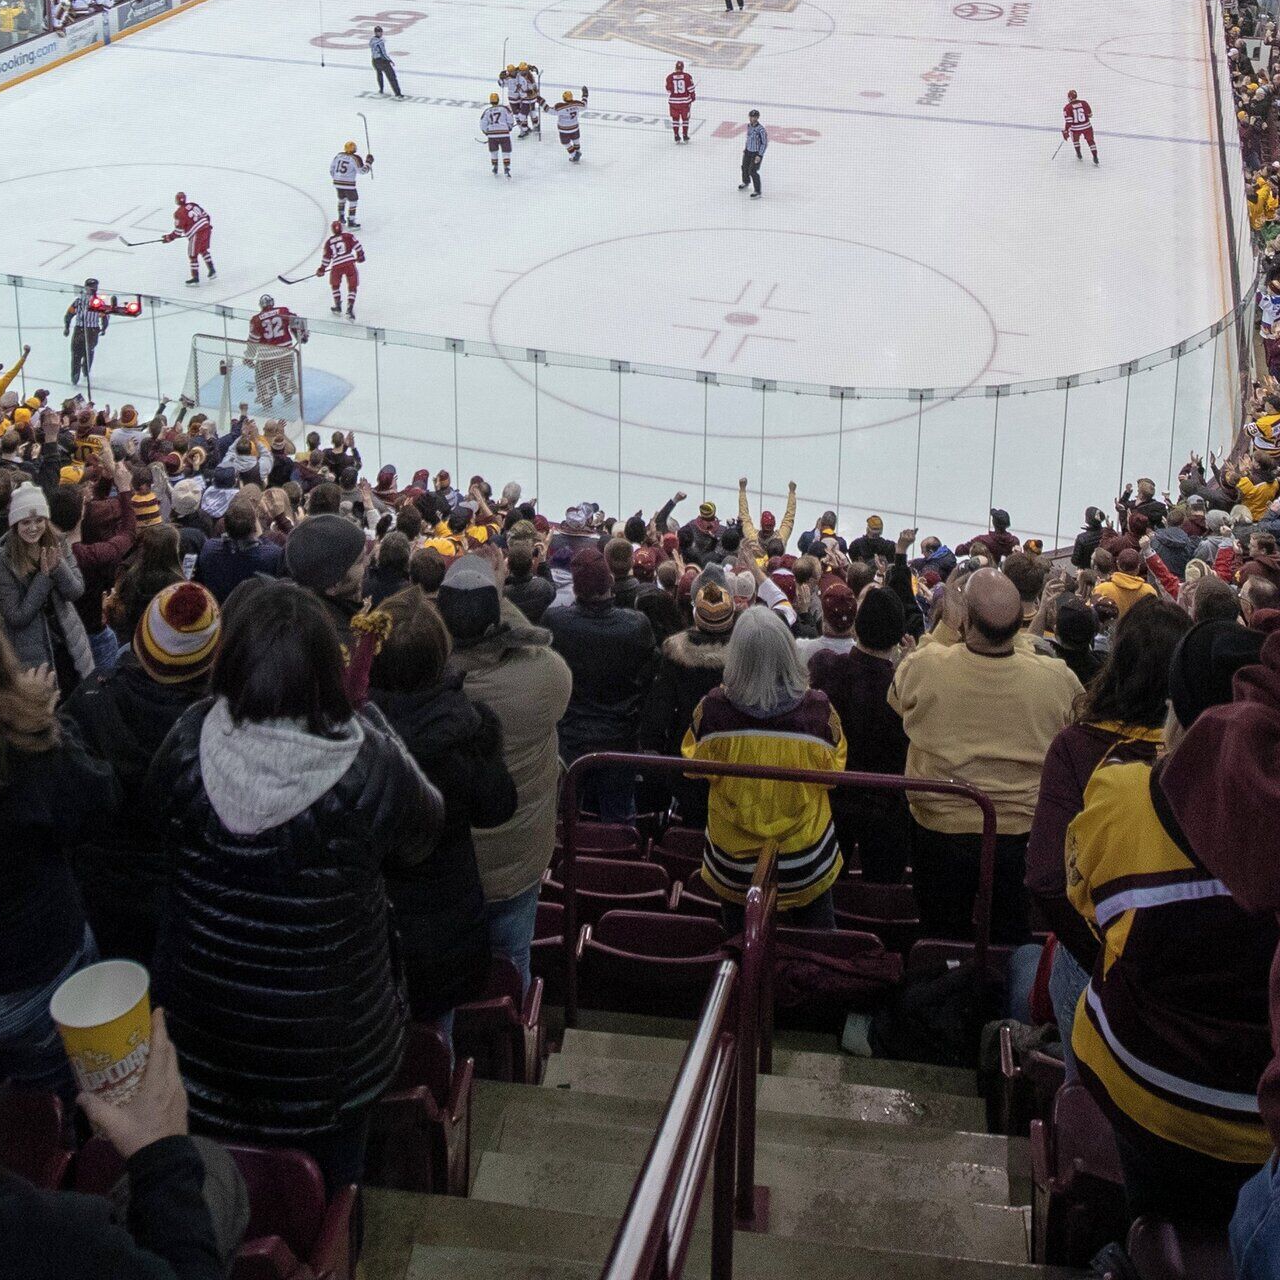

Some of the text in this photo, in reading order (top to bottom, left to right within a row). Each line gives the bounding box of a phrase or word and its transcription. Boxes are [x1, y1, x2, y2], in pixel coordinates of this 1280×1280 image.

[1006, 2, 1032, 27] TOYOTA
[310, 10, 427, 50] Cub
[673, 79, 686, 93] 19
[488, 112, 501, 124] 17
[1073, 108, 1086, 122] 16
[336, 160, 349, 174] 15
[332, 242, 346, 255] 13
[262, 317, 284, 339] 32
